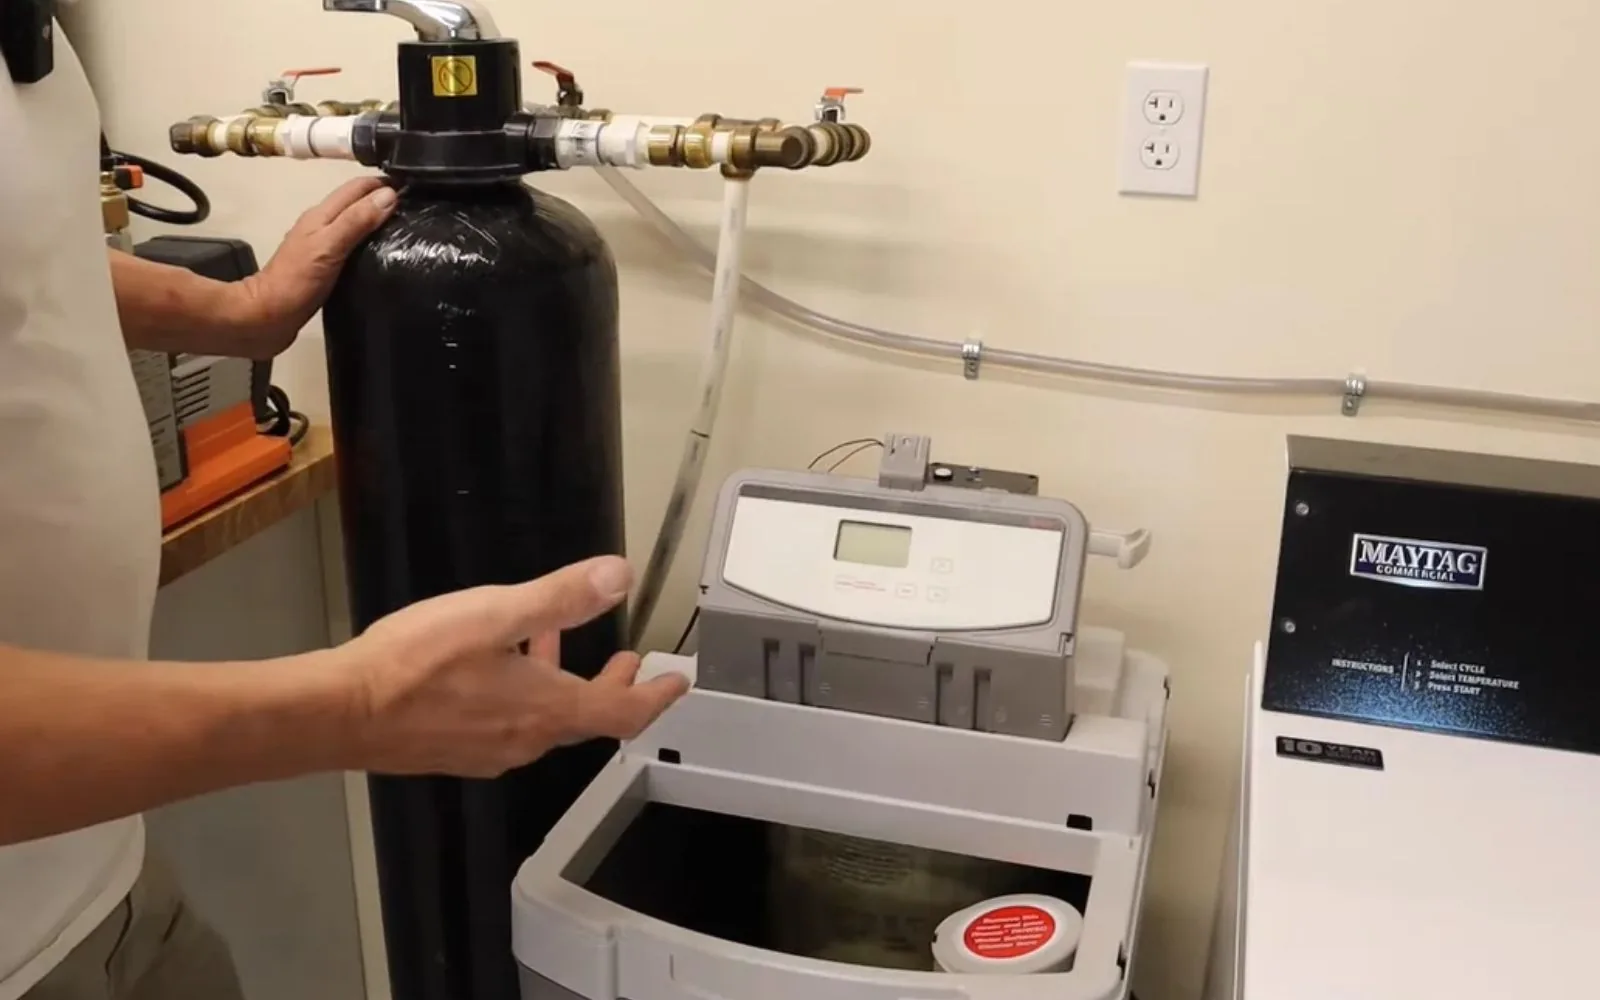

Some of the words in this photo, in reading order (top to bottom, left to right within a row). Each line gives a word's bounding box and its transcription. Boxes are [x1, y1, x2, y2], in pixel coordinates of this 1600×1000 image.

[1359, 540, 1479, 574] MAYTAG
[1375, 564, 1456, 582] COMMERCIAL
[1331, 658, 1395, 674] INSTRUCTIONS
[1430, 659, 1458, 672] Select
[1459, 662, 1486, 674] CYCLE
[1429, 670, 1457, 682] Select
[1458, 673, 1520, 689] TEMPERATURE
[1427, 681, 1452, 693] Press
[1453, 683, 1482, 695] START
[1282, 739, 1323, 755] 10
